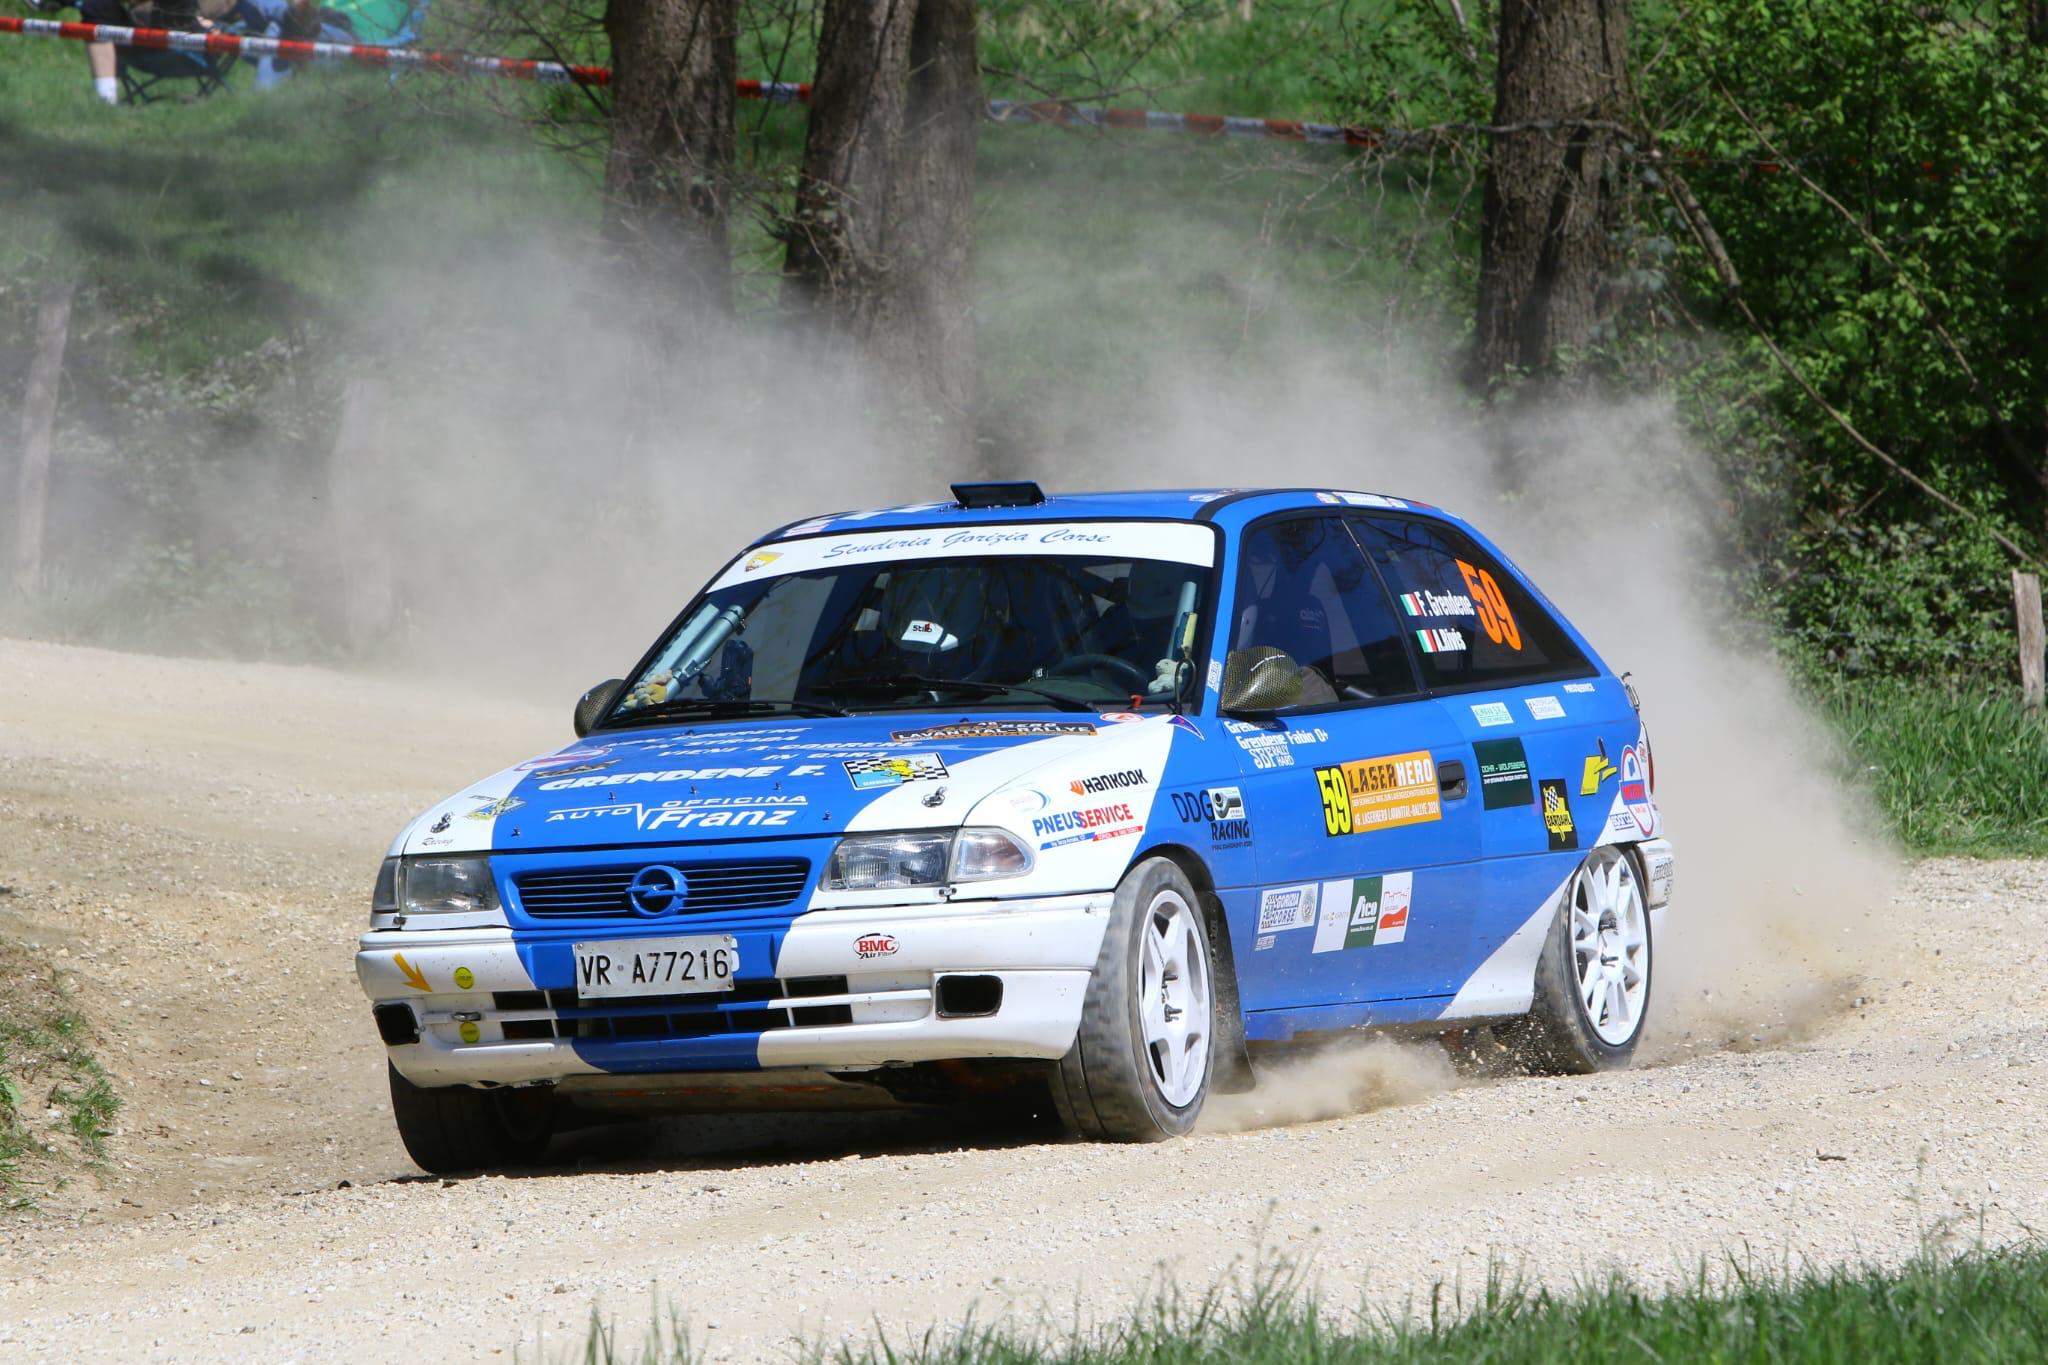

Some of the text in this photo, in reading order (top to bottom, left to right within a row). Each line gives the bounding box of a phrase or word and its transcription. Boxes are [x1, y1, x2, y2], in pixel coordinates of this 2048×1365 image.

[823, 529, 1112, 559] Scuderia Gorizia Corse
[1455, 558, 1522, 651] 59
[777, 741, 922, 750] CORRERE
[1235, 733, 1288, 749] Grendene
[1285, 730, 1316, 745] Fabio
[538, 765, 827, 791] GRENDENE F.
[662, 795, 809, 808] OFFICINA
[1315, 768, 1352, 835] 59
[545, 807, 634, 822] AUTO
[647, 809, 798, 831] Franz
[1032, 811, 1083, 837] PNEUS
[1078, 803, 1134, 829] SERVICE
[1211, 821, 1250, 841] RACING
[859, 940, 896, 952] BMC
[580, 949, 729, 987] VR A77216
